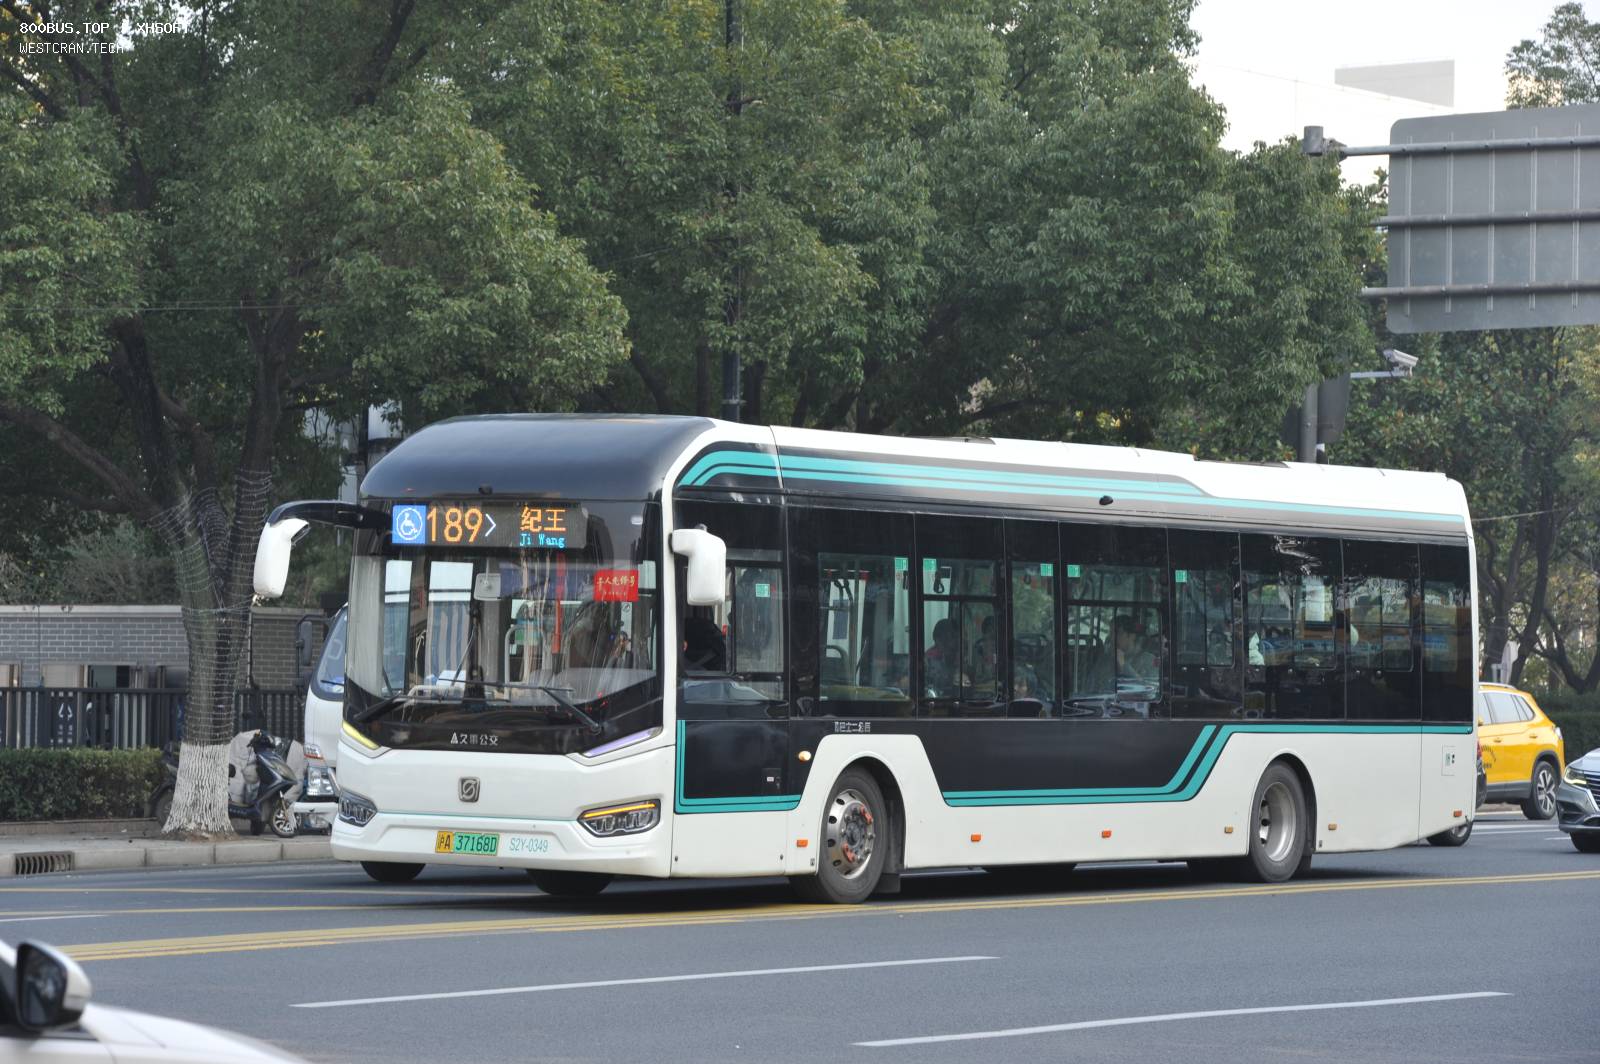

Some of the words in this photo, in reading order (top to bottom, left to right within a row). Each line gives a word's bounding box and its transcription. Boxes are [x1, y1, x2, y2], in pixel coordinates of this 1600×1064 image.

[427, 506, 483, 543] 189
[520, 506, 567, 533] 纪王
[520, 533, 532, 547] Ji
[538, 533, 566, 549] Wang
[509, 837, 549, 853] S2Y-0349
